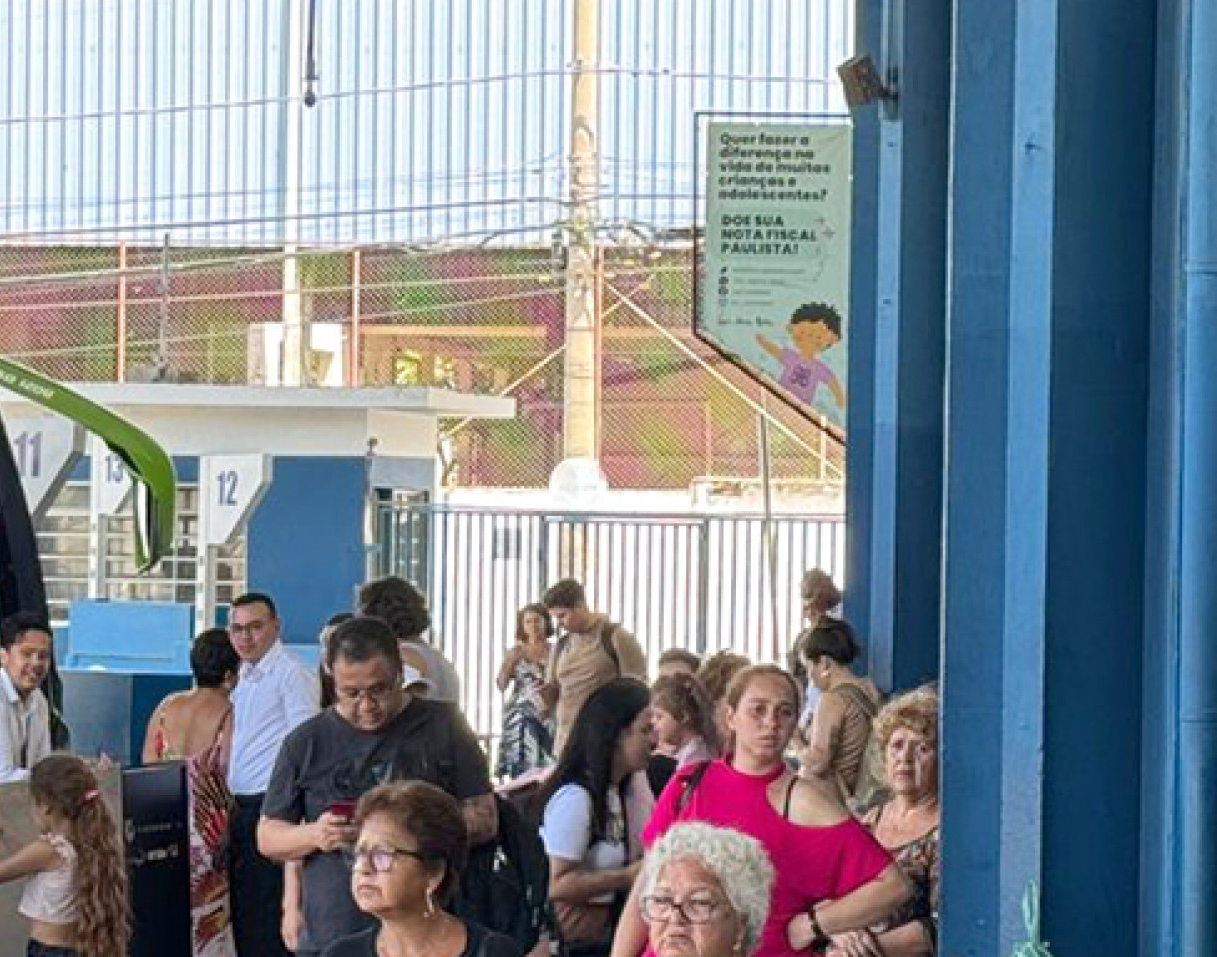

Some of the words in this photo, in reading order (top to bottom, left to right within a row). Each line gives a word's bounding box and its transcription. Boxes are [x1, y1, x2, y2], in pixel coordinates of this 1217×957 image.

[720, 132, 756, 147] Quer
[758, 132, 797, 146] fazer
[800, 136, 810, 146] a
[719, 147, 791, 162] diferença
[795, 150, 814, 160] na
[719, 160, 752, 173] vida
[755, 161, 772, 173] de
[775, 162, 830, 174] muitas
[718, 174, 784, 190] crianças
[787, 177, 797, 187] e
[718, 189, 827, 202] adolescentes?
[721, 214, 751, 227] DOE
[755, 215, 783, 227] SUA
[721, 228, 764, 240] NOTA
[767, 229, 817, 242] FISCAL
[721, 242, 799, 254] PAULISTA!
[13, 431, 42, 479] 11
[104, 454, 123, 483] 13
[216, 469, 238, 506] 12
